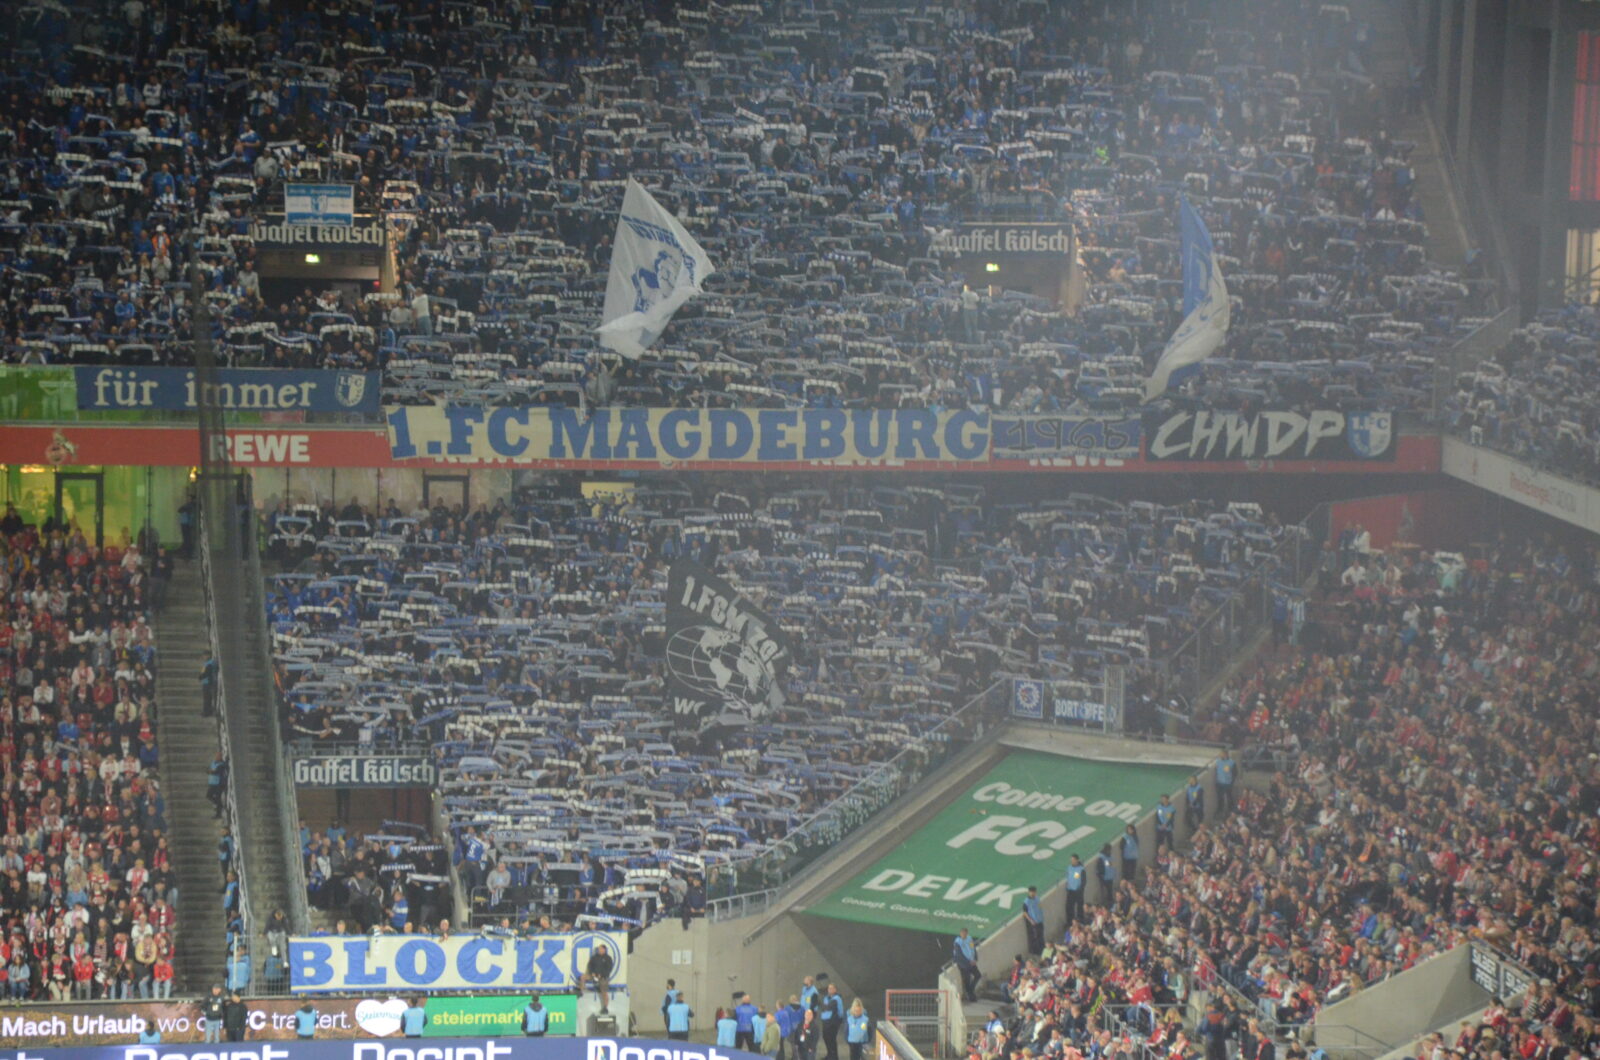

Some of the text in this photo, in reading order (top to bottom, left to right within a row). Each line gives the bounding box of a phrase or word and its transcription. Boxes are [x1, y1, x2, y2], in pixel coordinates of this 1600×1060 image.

[1005, 229, 1070, 254] Kölsch
[94, 368, 158, 407] für
[184, 371, 317, 408] immer
[208, 434, 311, 463] REWE
[388, 405, 990, 460] 1.FC MAGDEBURG
[1006, 417, 1132, 451] 1965
[1150, 409, 1346, 459] CHWDP
[294, 758, 435, 785] Gaffel Kölsch
[972, 781, 1086, 812] Come
[946, 815, 1097, 860] FC!
[861, 868, 1030, 910] DEVK
[289, 937, 565, 986] BLOCK
[2, 1016, 67, 1037] Mach
[72, 1013, 146, 1036] Urlaub
[157, 1018, 190, 1033] wo
